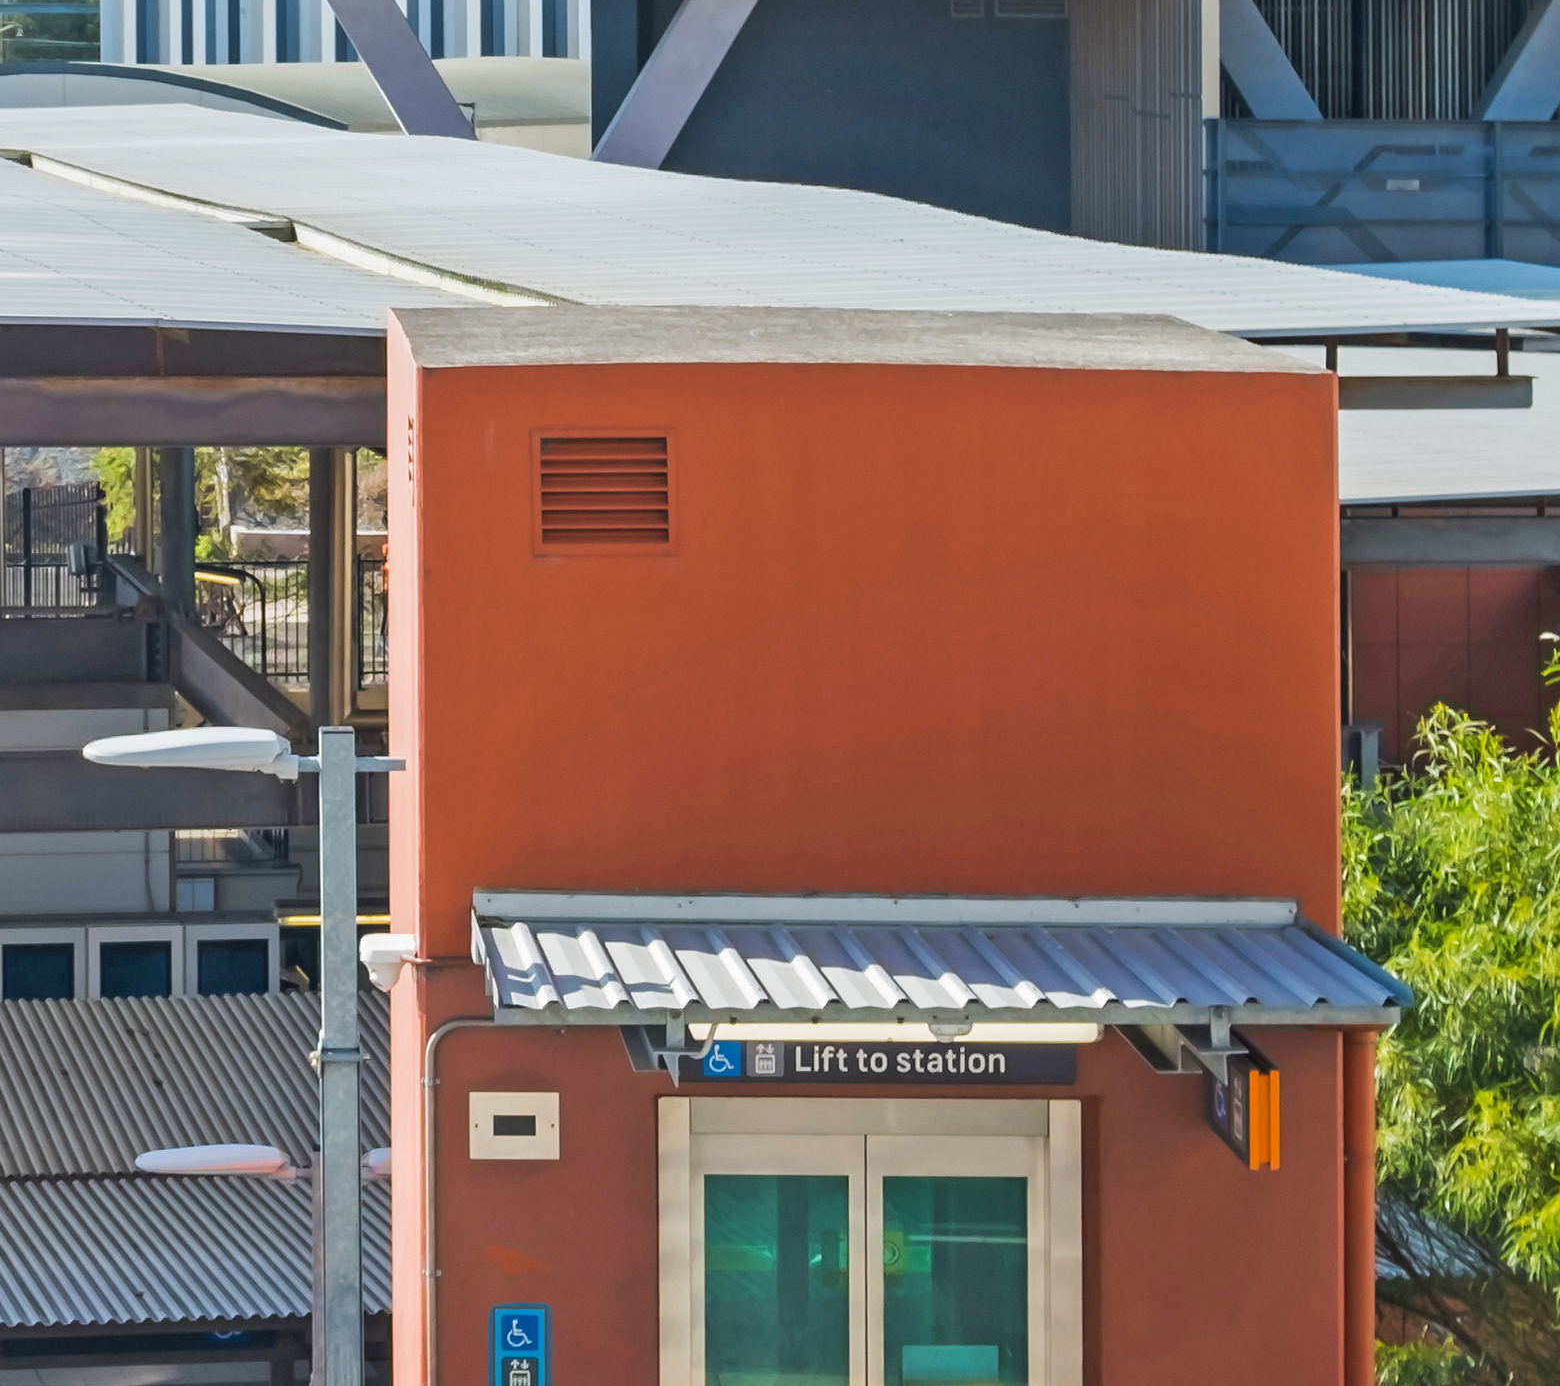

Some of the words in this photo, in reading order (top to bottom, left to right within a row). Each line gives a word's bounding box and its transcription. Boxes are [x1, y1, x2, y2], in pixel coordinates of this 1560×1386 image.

[794, 1045, 848, 1074] Lift
[856, 1048, 888, 1074] to
[896, 1046, 1007, 1075] station
